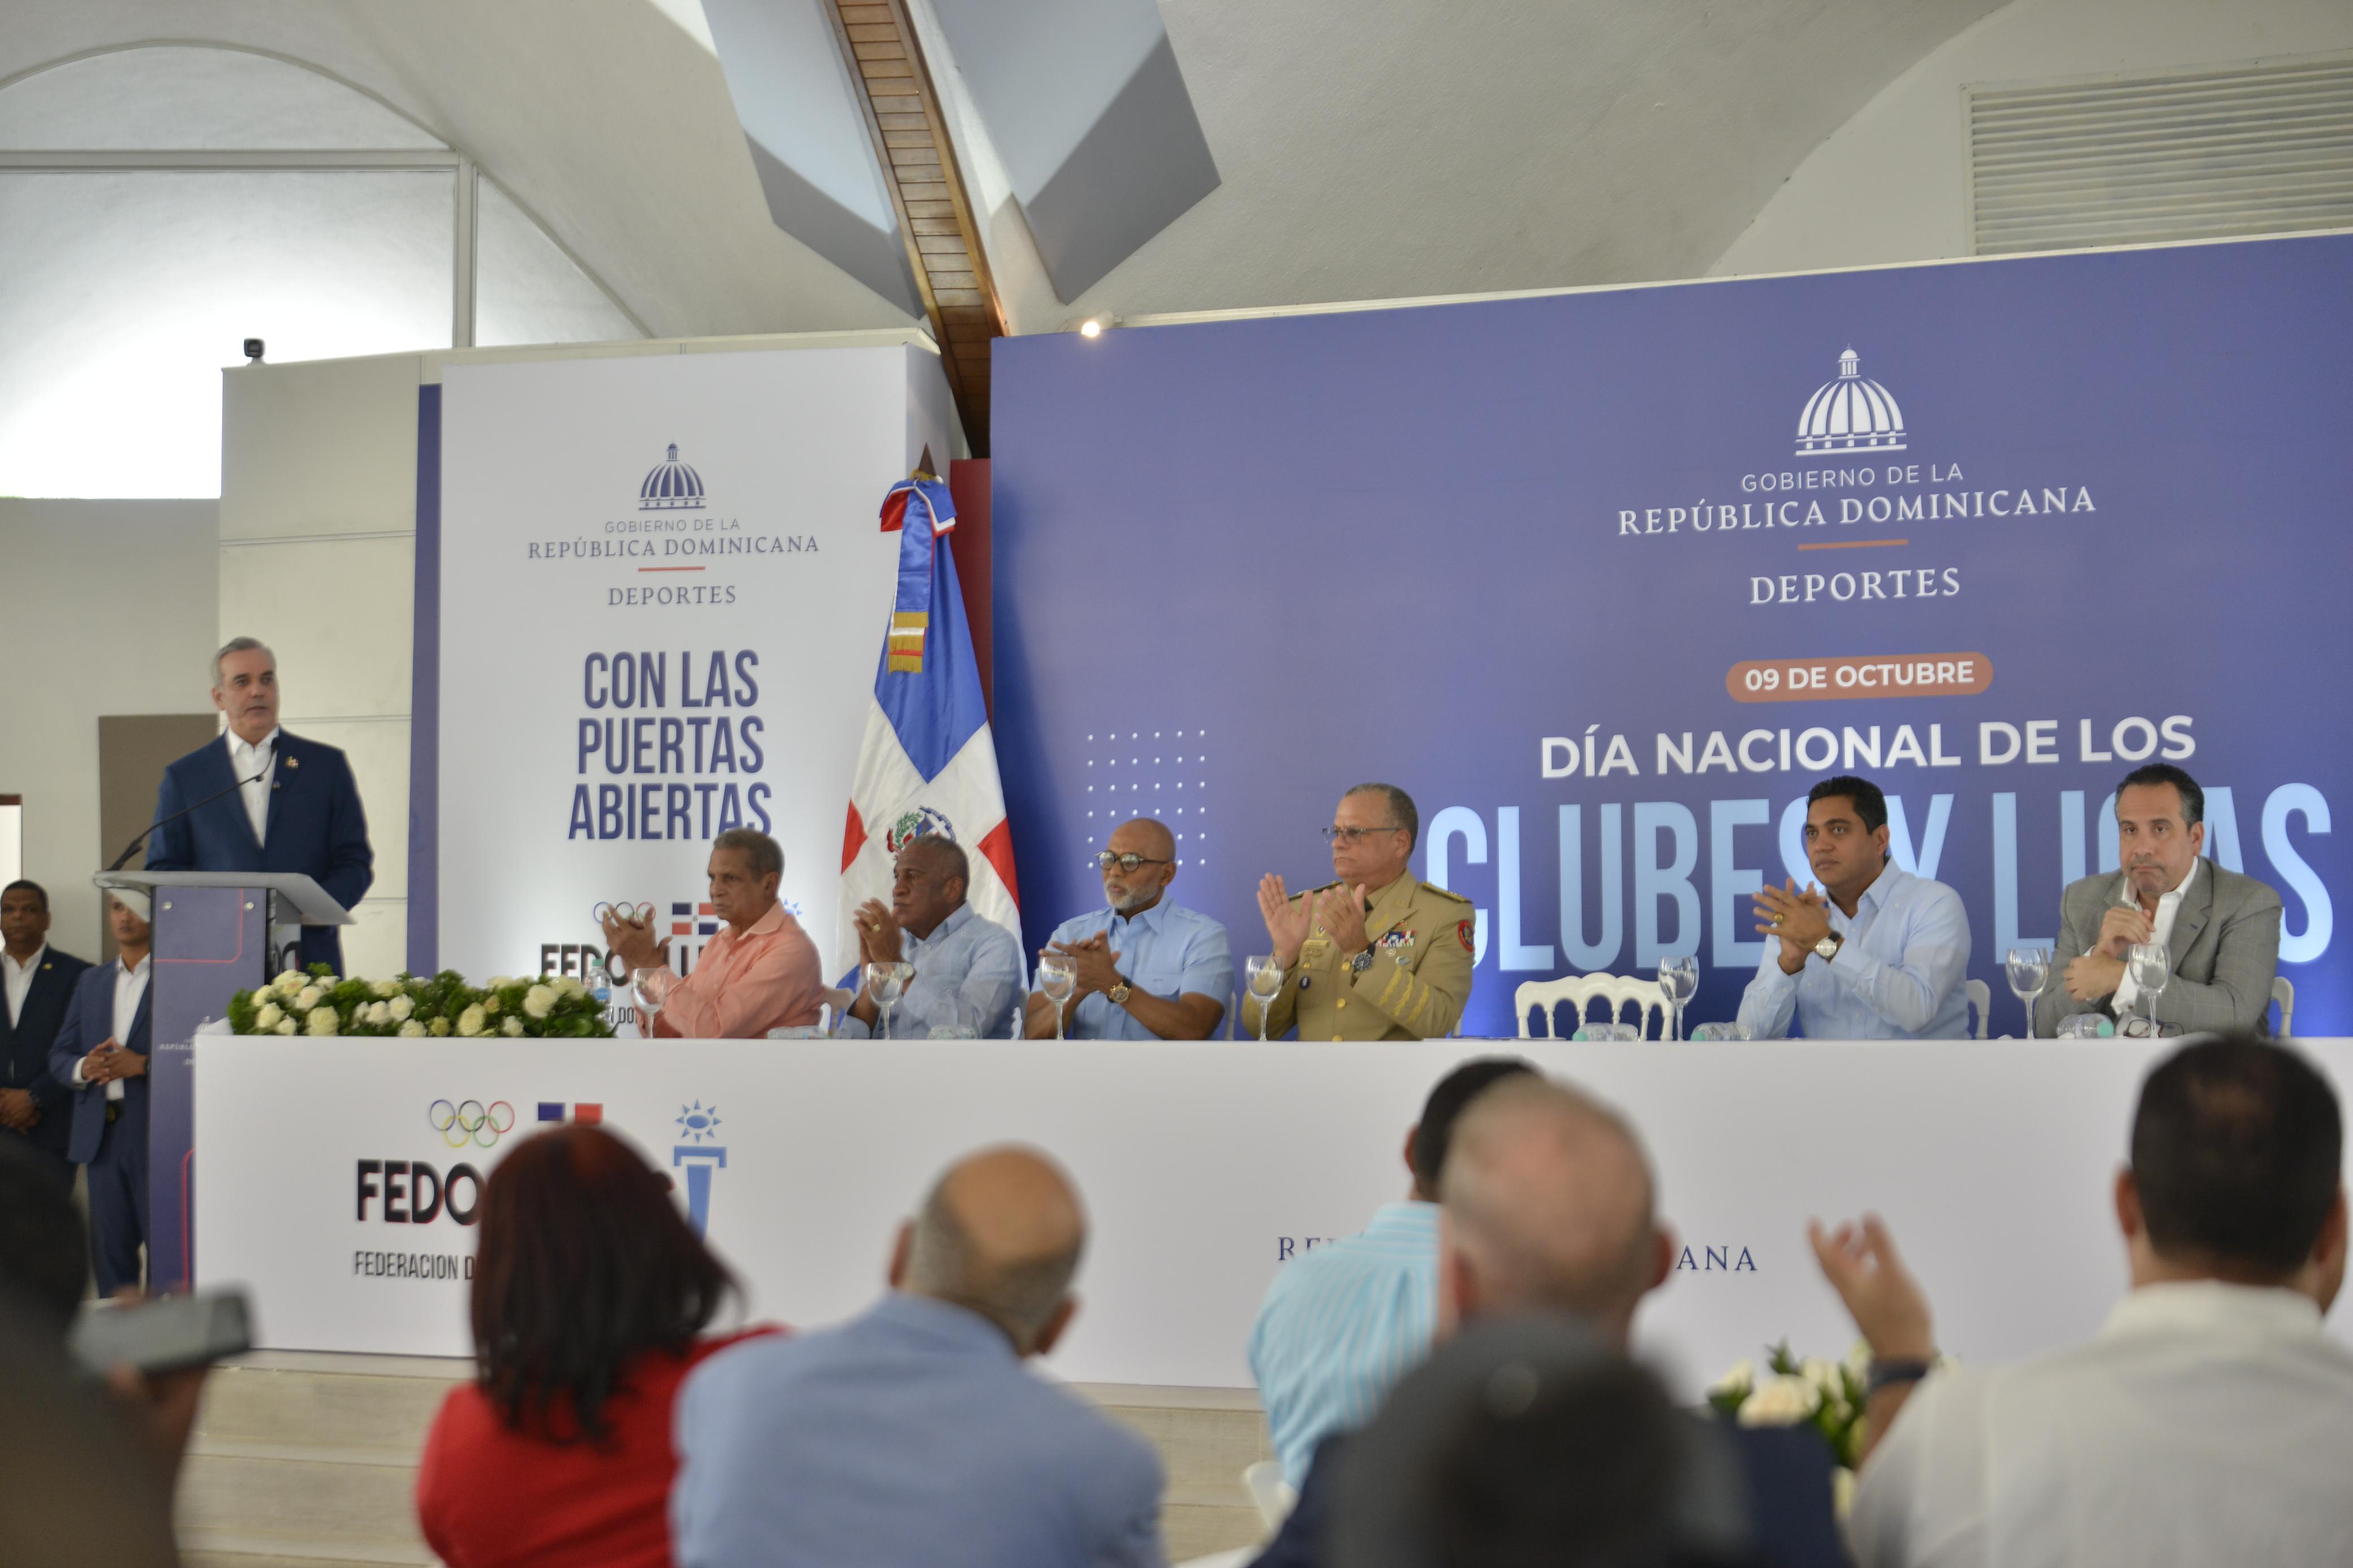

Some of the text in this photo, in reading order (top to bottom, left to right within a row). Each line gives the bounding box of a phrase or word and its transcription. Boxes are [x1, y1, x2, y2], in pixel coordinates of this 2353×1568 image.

[1742, 463, 1964, 493] GOBIERNO DE LA
[605, 518, 740, 533] GOBIERNO DE LA
[1619, 486, 2096, 535] REPÚBLICA DOMINICANA
[528, 535, 819, 559] REPÚBLICA DOMINICANA
[608, 585, 736, 606] DEPORTES
[1749, 567, 1960, 604] DEPORTES
[584, 649, 759, 709] CON LAS
[1745, 660, 1975, 691] 09 DE OCTUBRE
[578, 715, 765, 774] PUERTAS
[1541, 715, 2196, 779] DÍA NACIONAL DE LOS
[568, 781, 772, 840] ABIERTAS
[1993, 783, 2333, 964] LIS
[355, 1250, 459, 1280] FEDERACION
